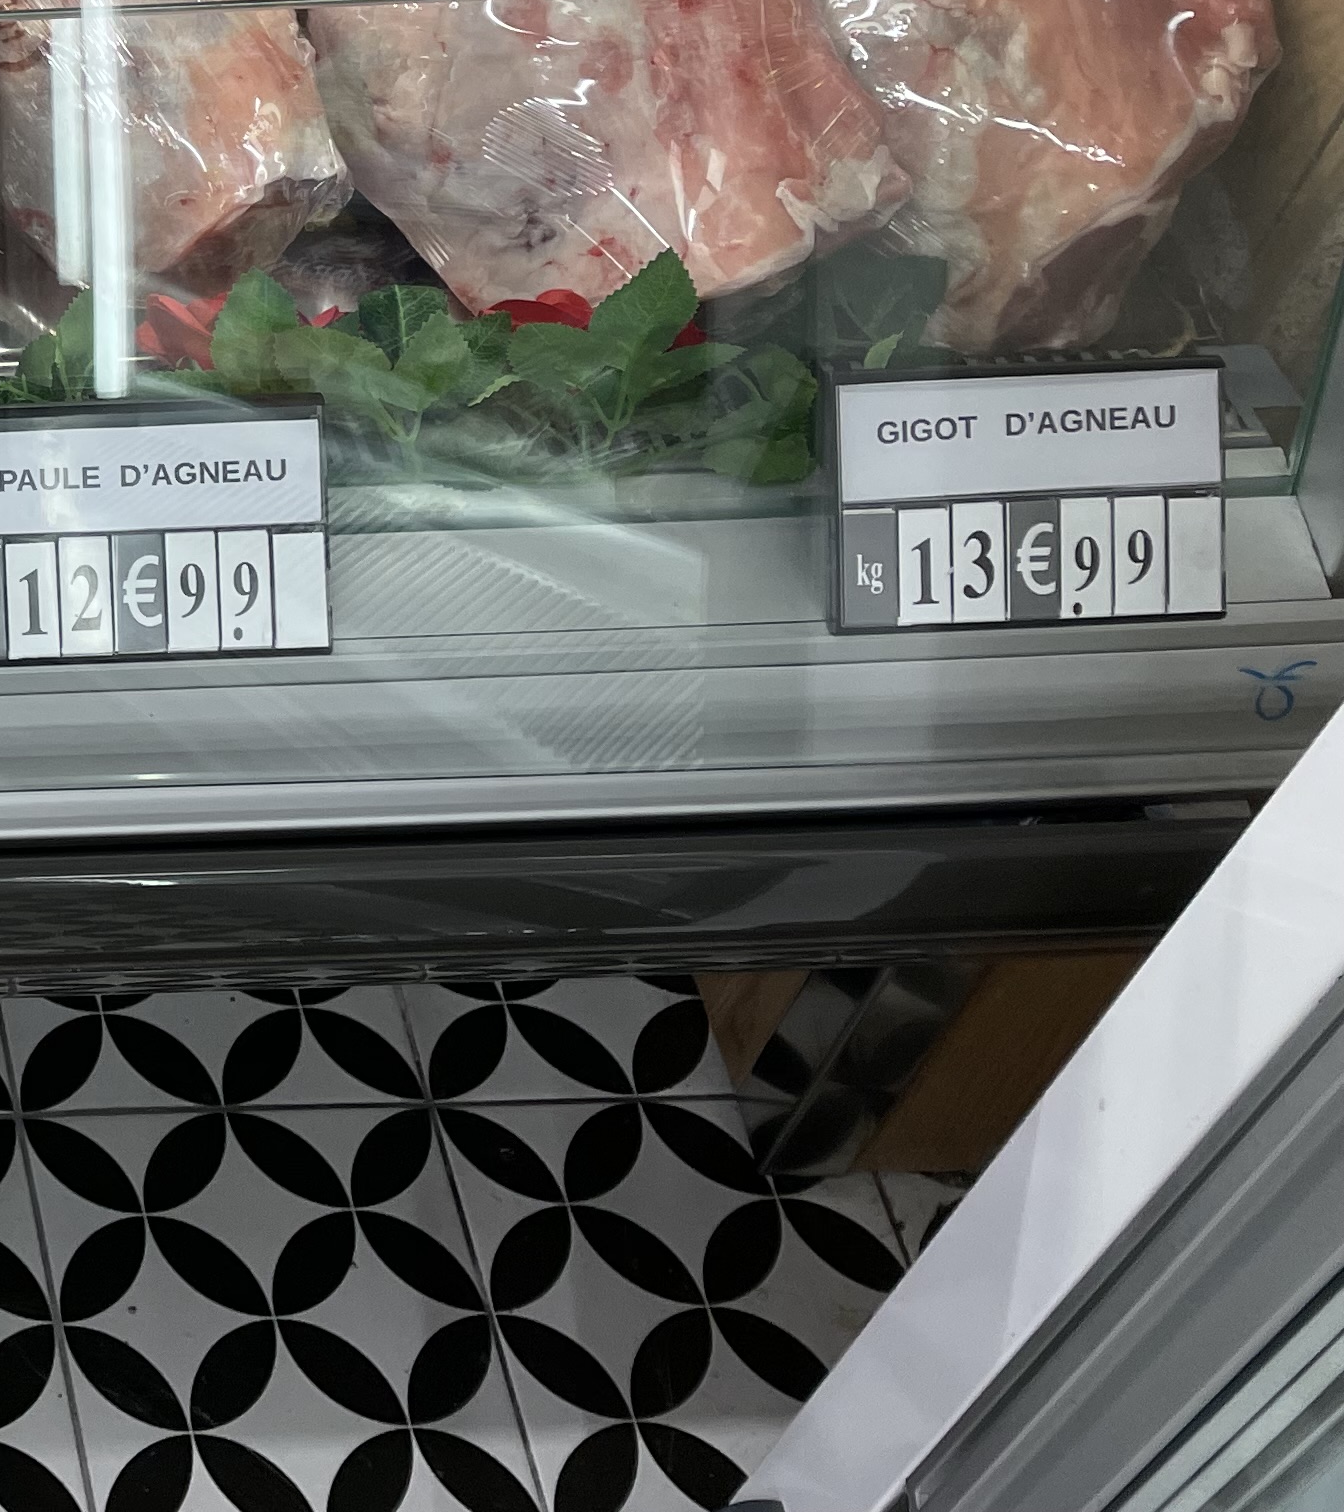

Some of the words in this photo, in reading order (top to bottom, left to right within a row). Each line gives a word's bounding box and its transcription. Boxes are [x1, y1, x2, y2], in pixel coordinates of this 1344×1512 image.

[876, 415, 978, 446] GIGOT
[1005, 404, 1177, 437] D'AGNEAU
[119, 458, 288, 488] D'AGNEAU
[856, 554, 884, 594] kg
